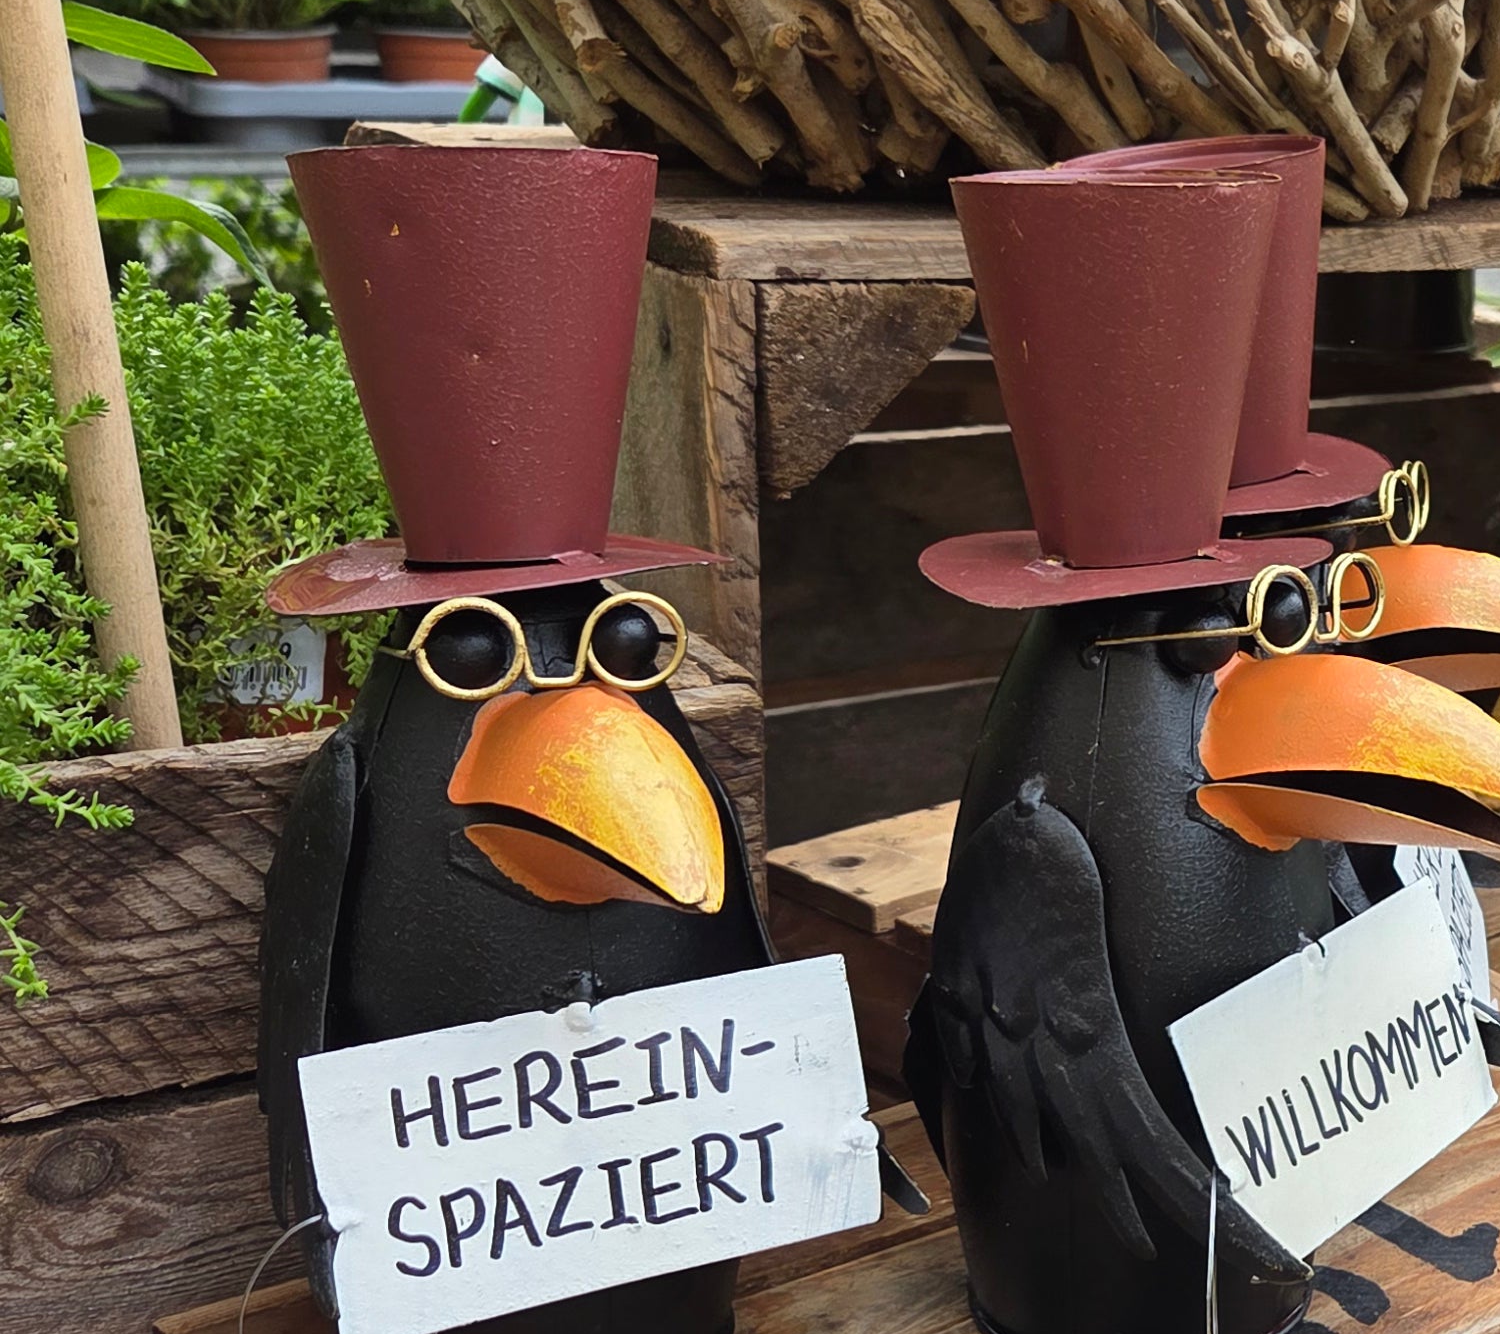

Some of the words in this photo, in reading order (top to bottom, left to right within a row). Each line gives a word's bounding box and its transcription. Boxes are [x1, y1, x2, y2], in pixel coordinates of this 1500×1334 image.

[391, 1019, 776, 1148] HEREIN-
[1225, 982, 1472, 1187] WILLKOMMEN
[388, 1122, 784, 1277] SPAZIERT
